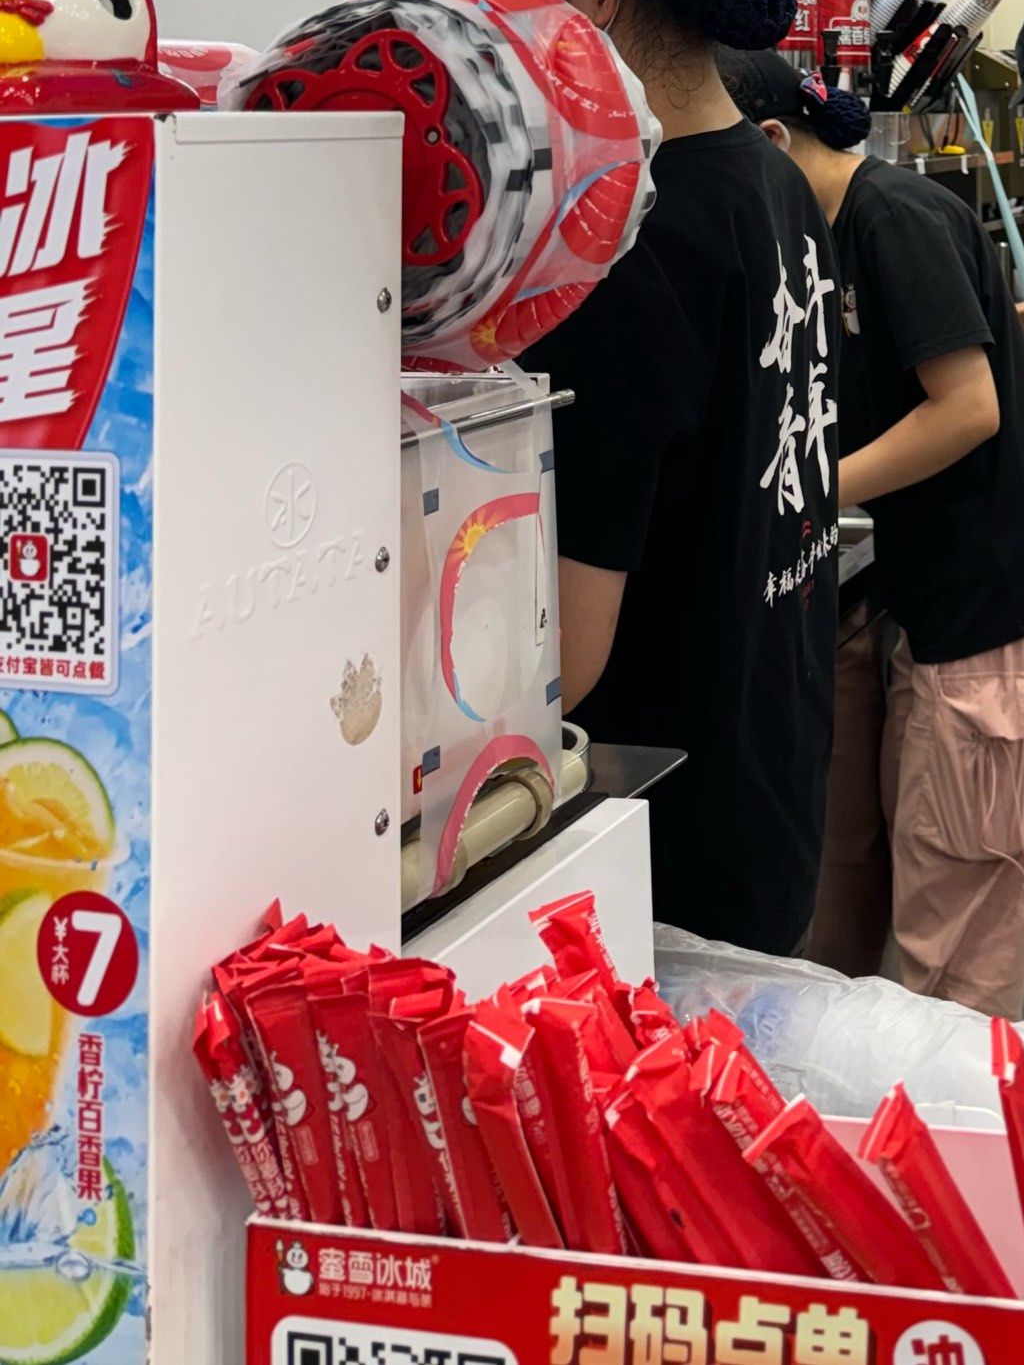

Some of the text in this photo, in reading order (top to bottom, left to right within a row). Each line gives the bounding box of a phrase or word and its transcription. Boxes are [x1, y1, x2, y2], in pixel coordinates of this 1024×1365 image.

[50, 945, 70, 987] 大杯
[71, 909, 123, 1007] 7
[77, 1032, 104, 1202] 香柠百香果
[318, 1247, 432, 1292] 蜜雪冰城
[549, 1275, 871, 1365] 扫码点单
